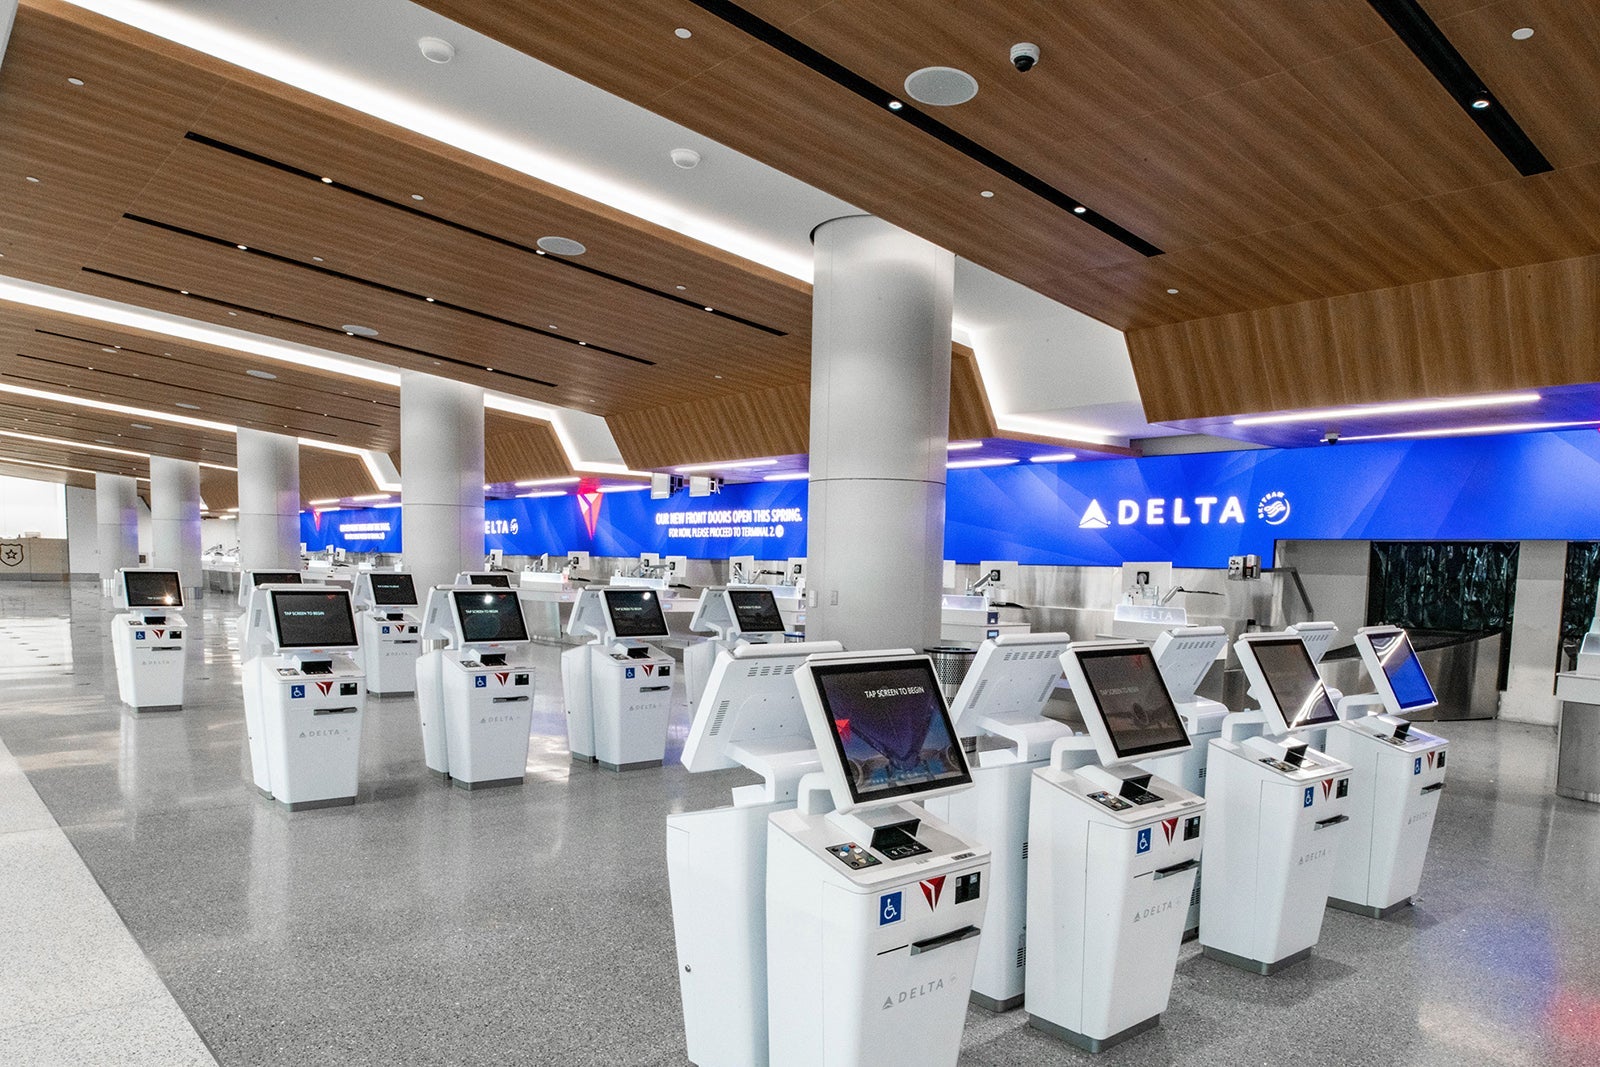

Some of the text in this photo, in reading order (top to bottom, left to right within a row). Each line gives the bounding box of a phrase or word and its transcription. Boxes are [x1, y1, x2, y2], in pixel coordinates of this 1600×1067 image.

[656, 508, 803, 525] OUR NEW FRONT DOORS OPEN THIS SPRING.
[1117, 496, 1245, 525] DELTA
[484, 520, 509, 535] ELTA
[668, 528, 678, 538] FOR
[692, 527, 709, 538] PLEASE
[709, 527, 733, 538] PROCEED
[733, 527, 741, 537] TO
[741, 526, 769, 537] TERMINAL
[864, 686, 925, 698] TAP SCREEN TO BEGIN
[309, 729, 340, 737] DELTA
[1143, 900, 1172, 919] DELTA
[898, 978, 944, 1003] DELTA
